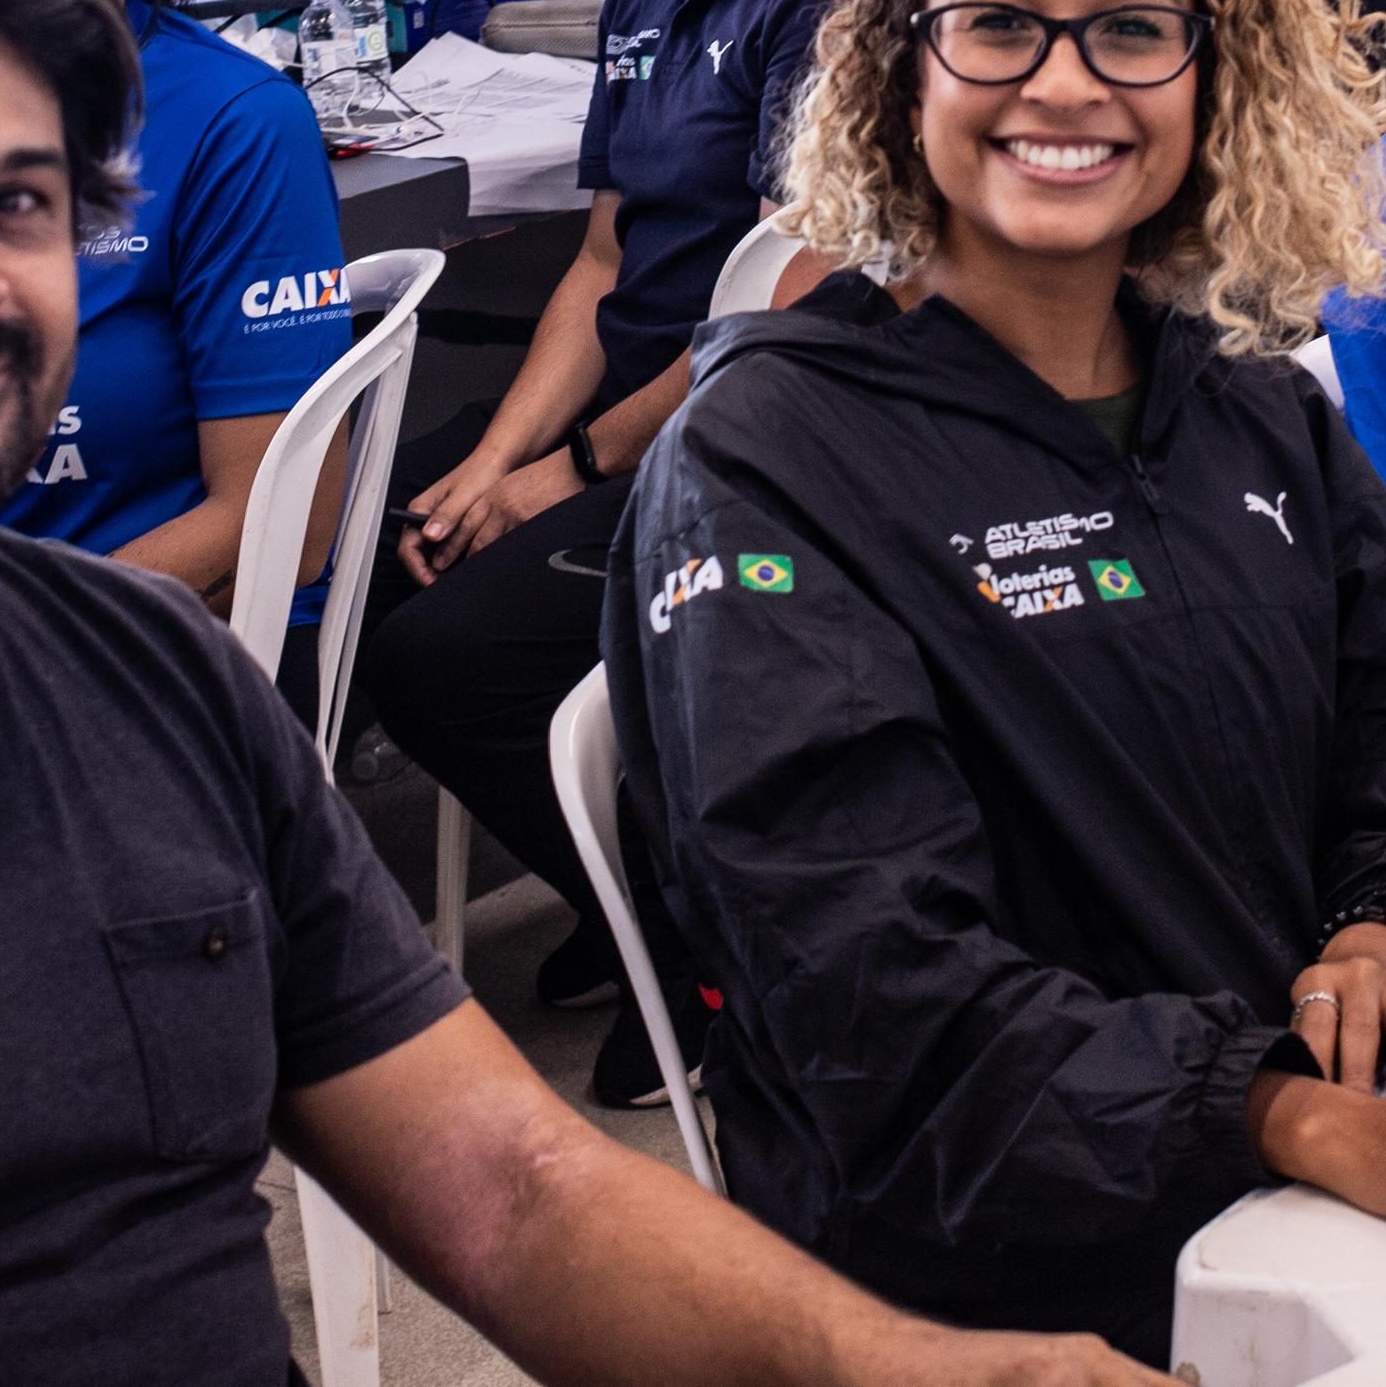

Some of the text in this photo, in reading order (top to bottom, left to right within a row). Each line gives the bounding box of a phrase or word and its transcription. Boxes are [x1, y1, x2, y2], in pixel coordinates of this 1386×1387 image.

[986, 531, 1084, 560] BRASIL
[649, 555, 724, 634] CIXA
[989, 563, 1077, 599] loterias
